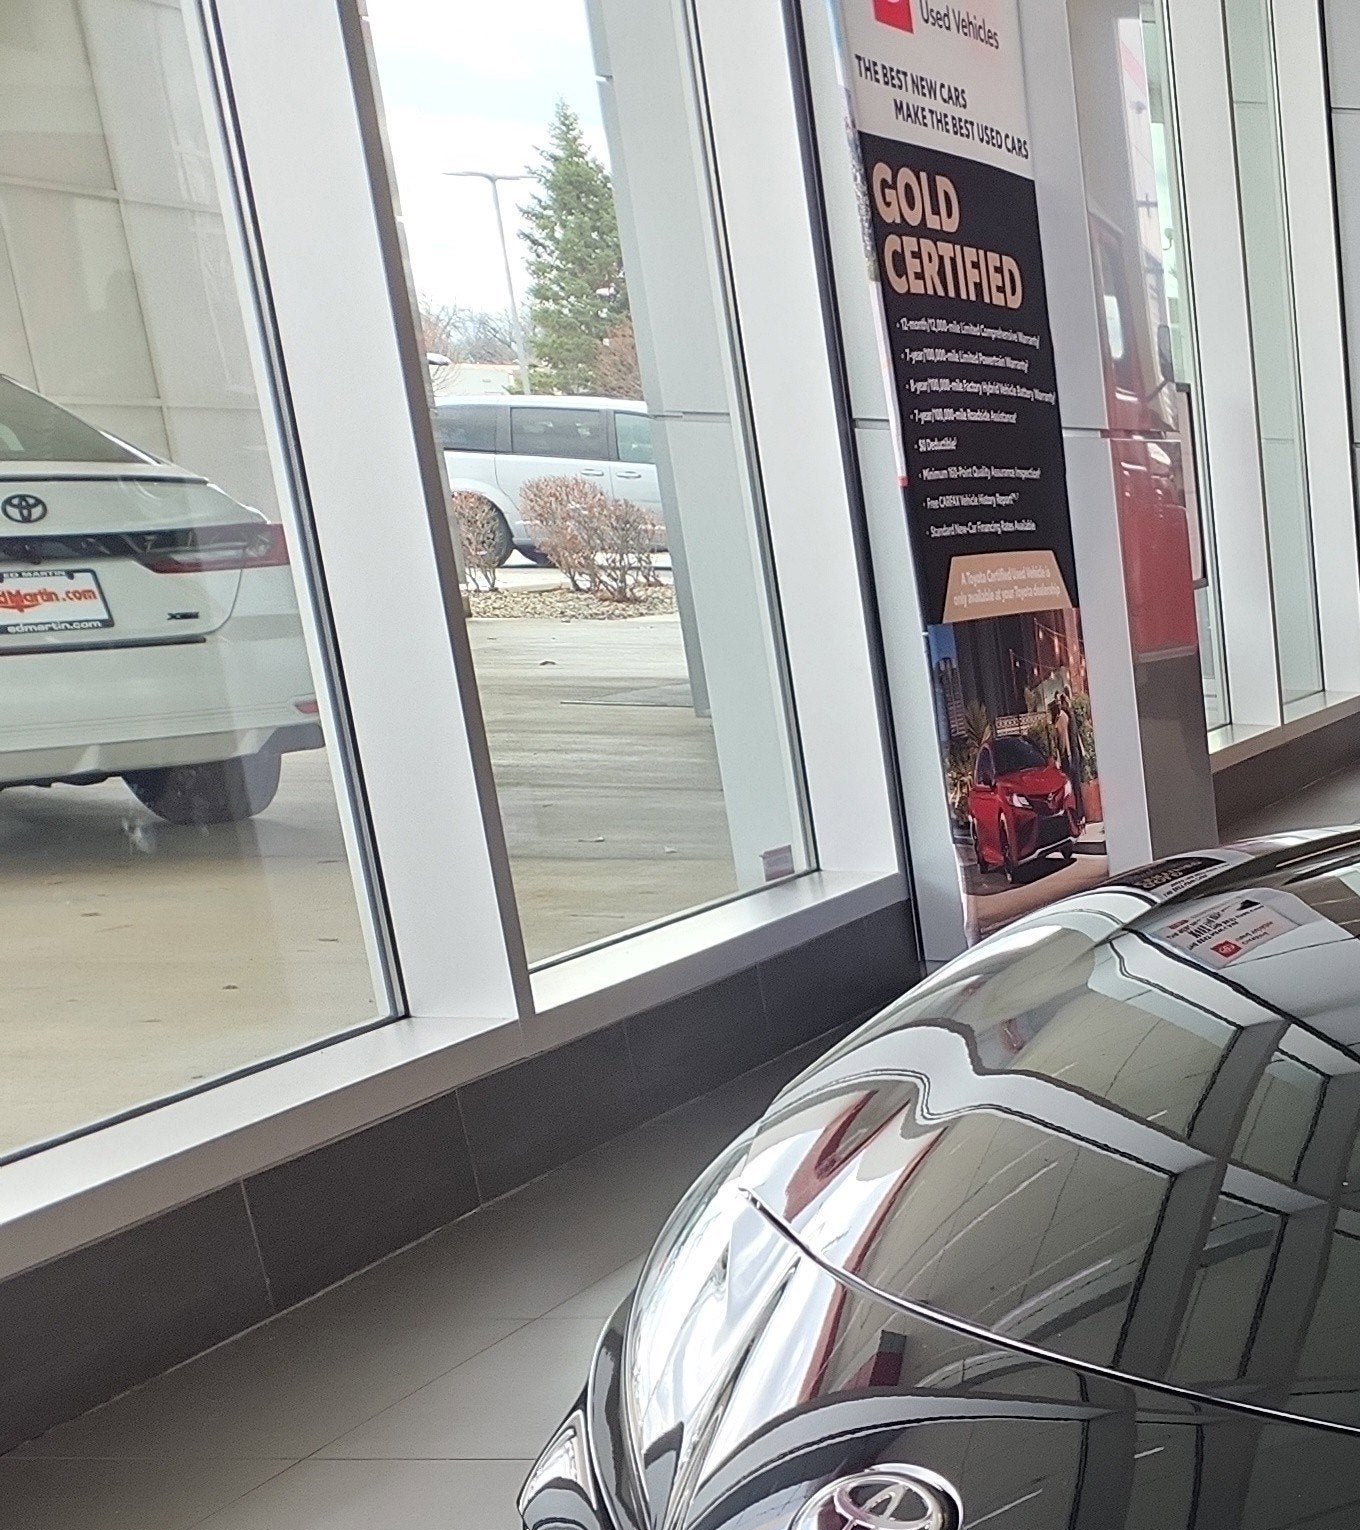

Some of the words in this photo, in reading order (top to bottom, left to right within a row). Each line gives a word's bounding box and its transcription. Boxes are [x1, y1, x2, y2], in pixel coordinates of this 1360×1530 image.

[920, 0, 951, 31] Used
[952, 9, 1000, 49] Vehicles
[854, 53, 881, 85] THE
[881, 64, 909, 93] BEST
[910, 73, 938, 101] NEW
[939, 82, 968, 110] CARS
[893, 98, 929, 128] MAKE
[928, 109, 951, 134] THE
[951, 114, 976, 141] BEST
[976, 123, 1003, 150] USED
[1004, 132, 1030, 160] CARS
[872, 162, 960, 233] GOLD
[884, 233, 1023, 309] CERTIFIED
[7, 619, 102, 634] edmartin.com
